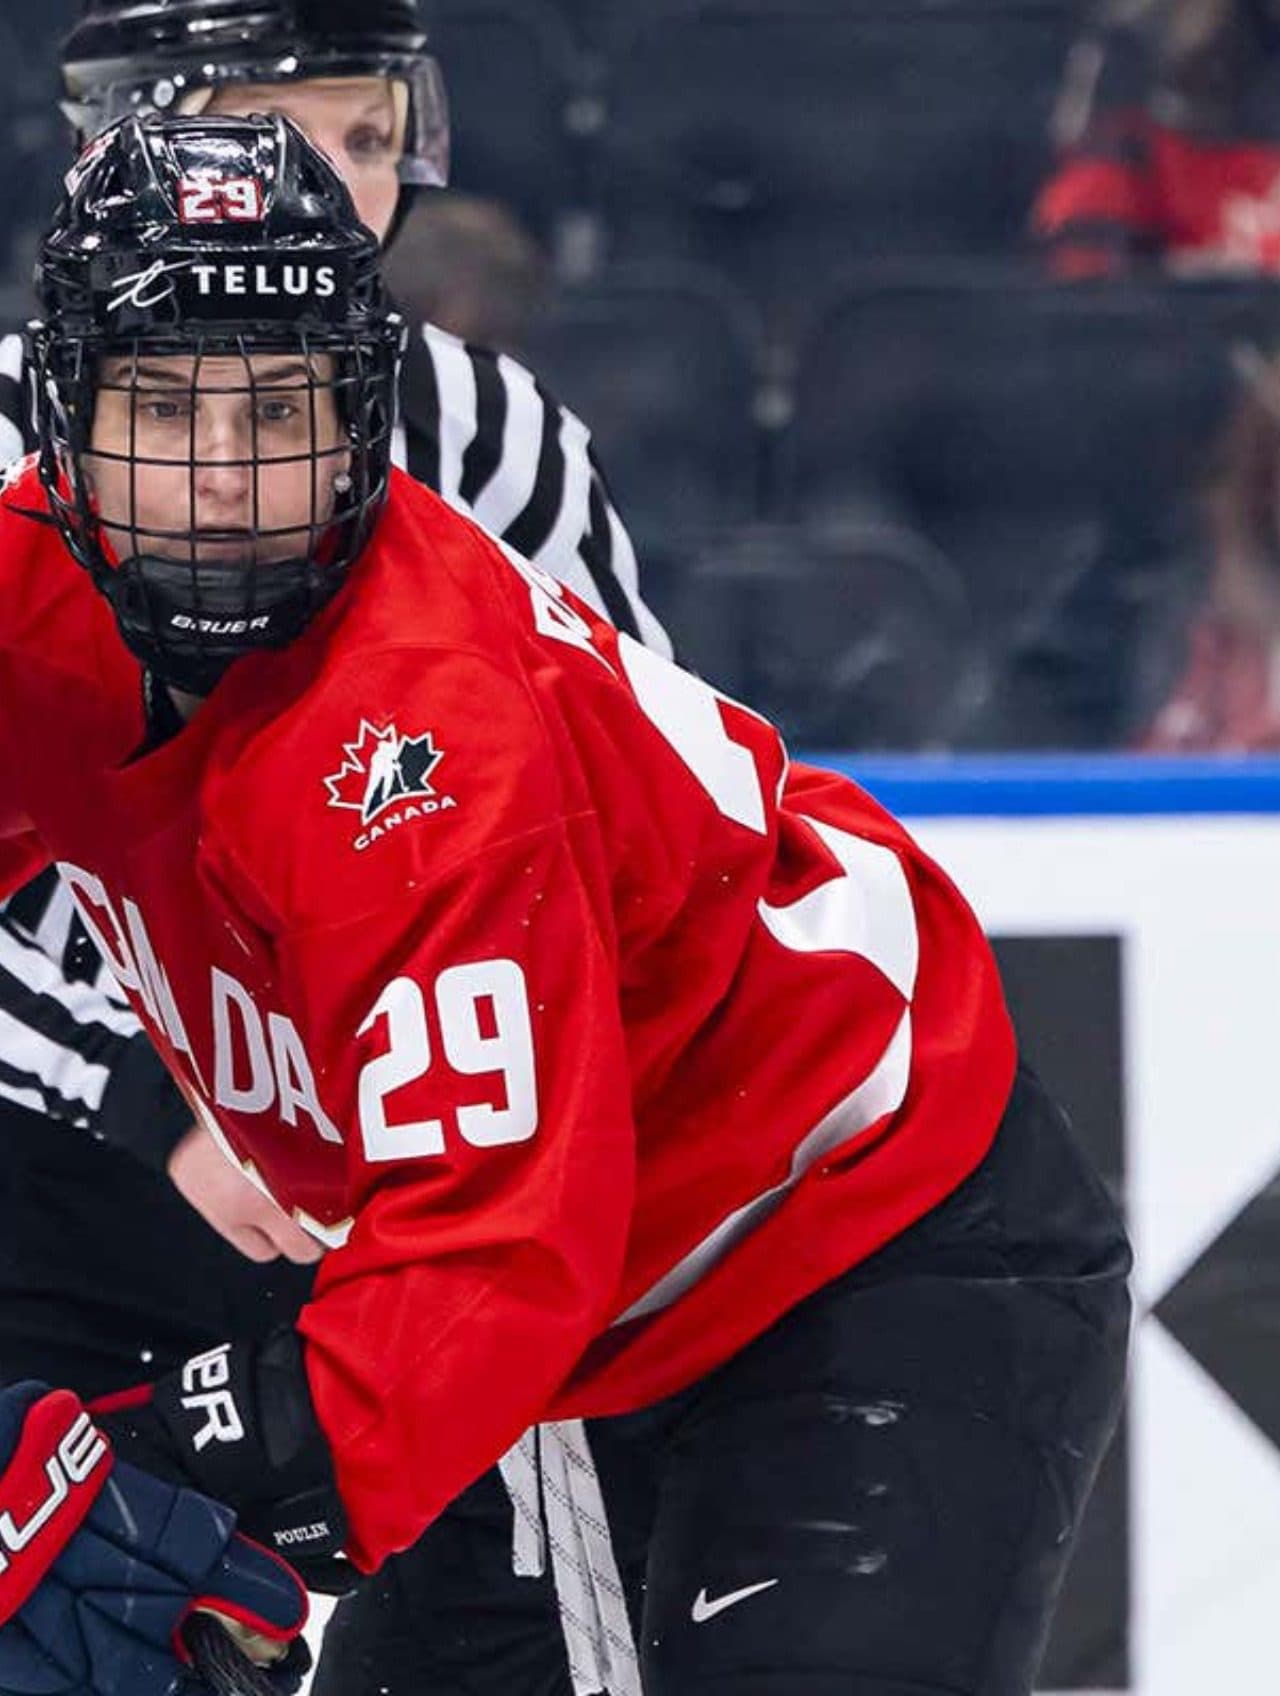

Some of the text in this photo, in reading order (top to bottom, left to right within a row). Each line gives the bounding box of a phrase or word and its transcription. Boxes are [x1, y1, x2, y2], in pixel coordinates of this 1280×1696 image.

[177, 176, 265, 225] 29
[191, 265, 336, 296] TELUS
[170, 613, 271, 634] BAUER
[353, 795, 458, 851] CANADA
[355, 958, 539, 1163] 29
[273, 1521, 330, 1546] POULIN
